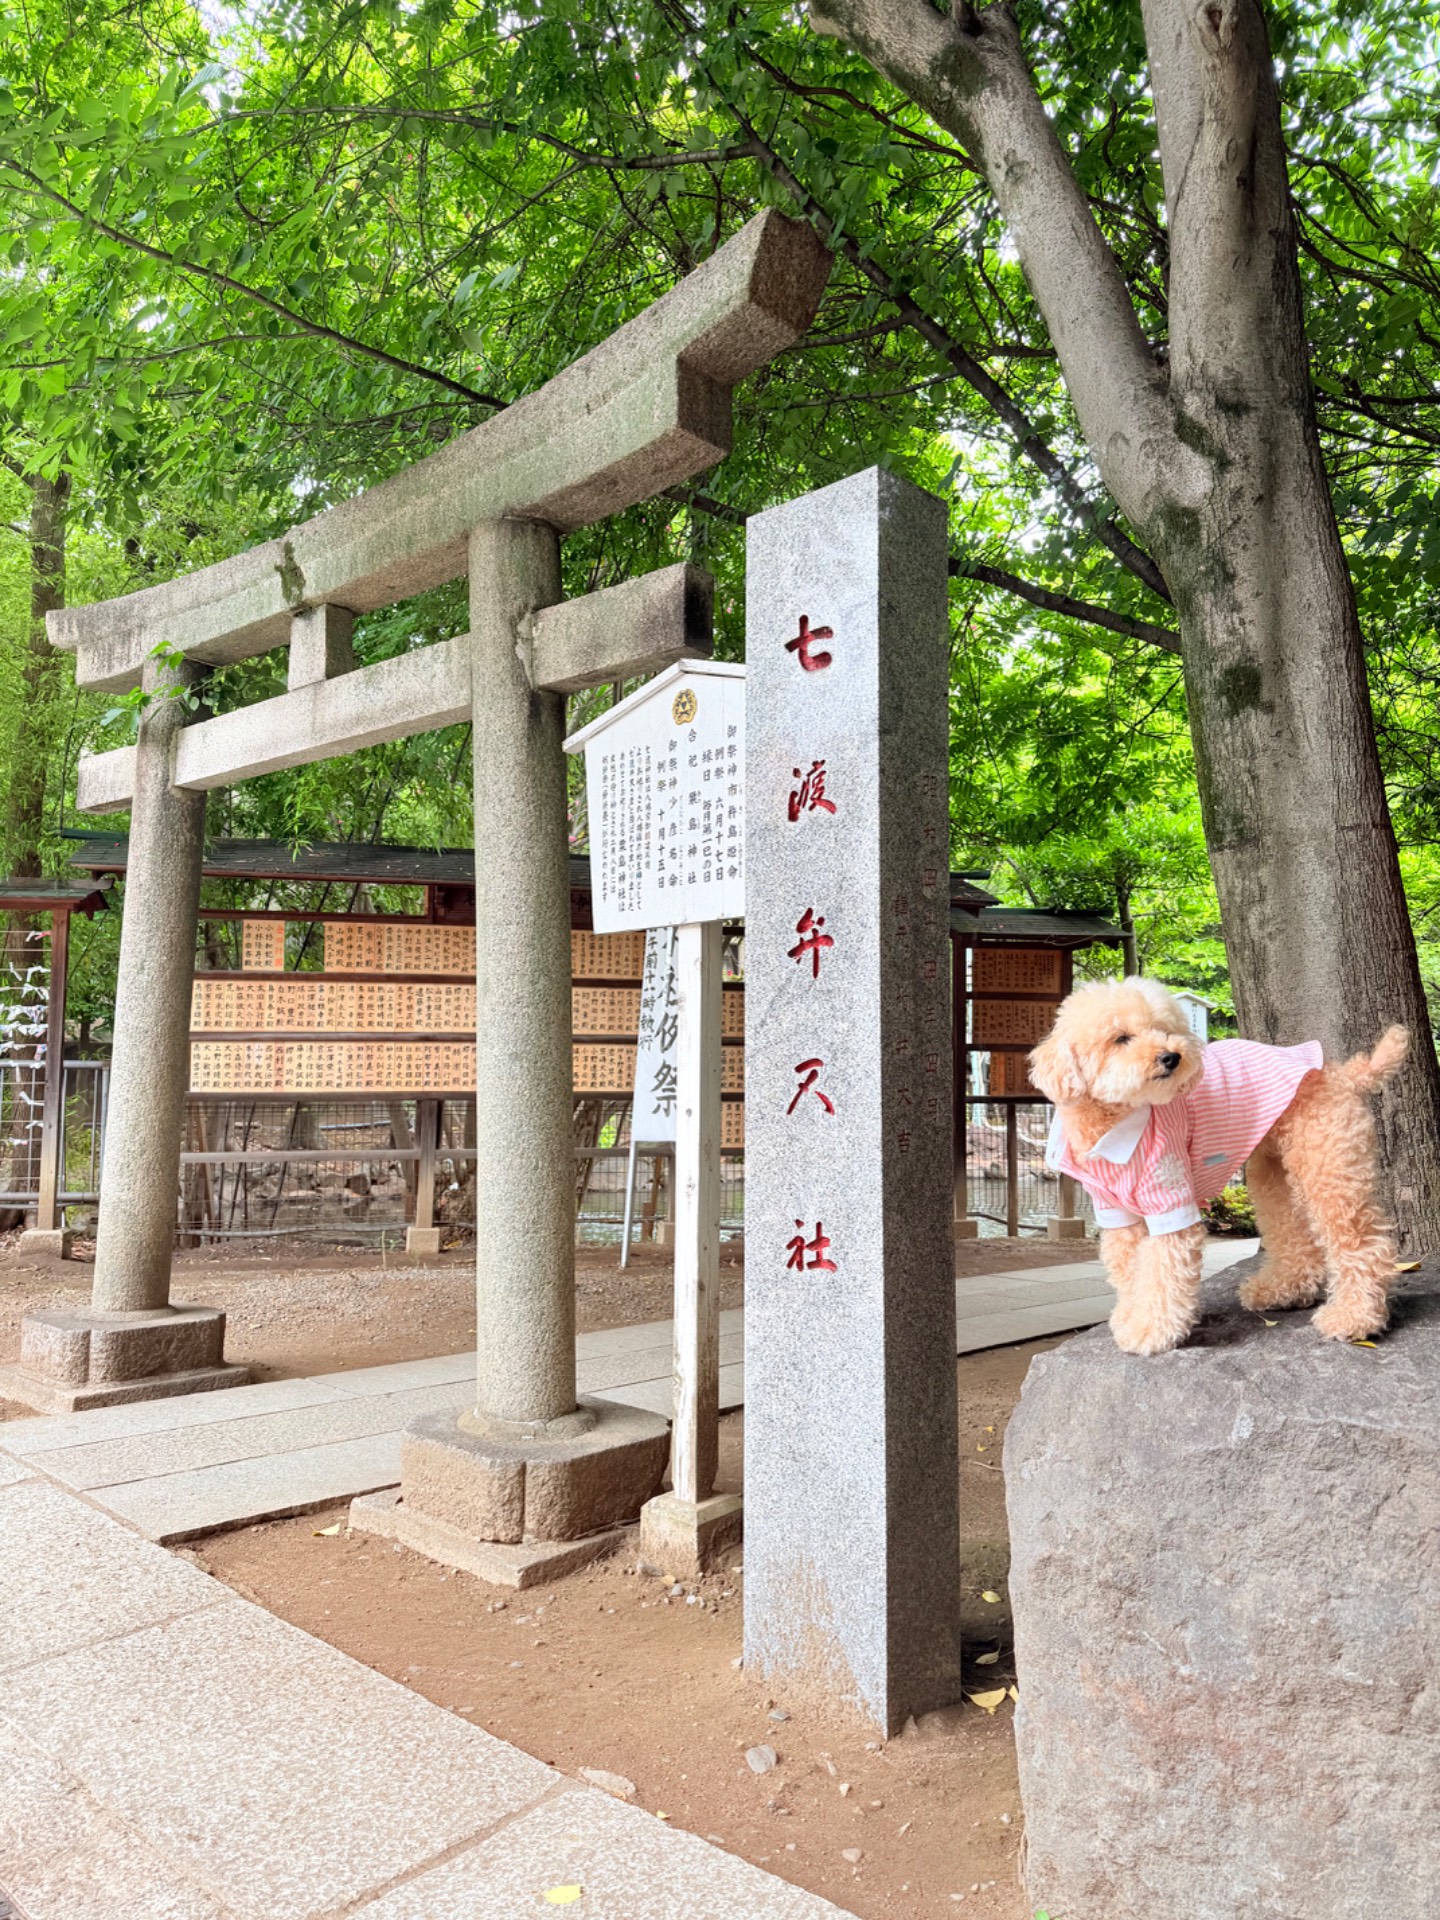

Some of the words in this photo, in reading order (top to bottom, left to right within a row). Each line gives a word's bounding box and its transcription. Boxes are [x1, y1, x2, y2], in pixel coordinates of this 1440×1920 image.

[656, 809, 667, 890] 十月十五日
[714, 796, 724, 882] 六月十七日
[638, 927, 659, 1052] 午前十一時執行
